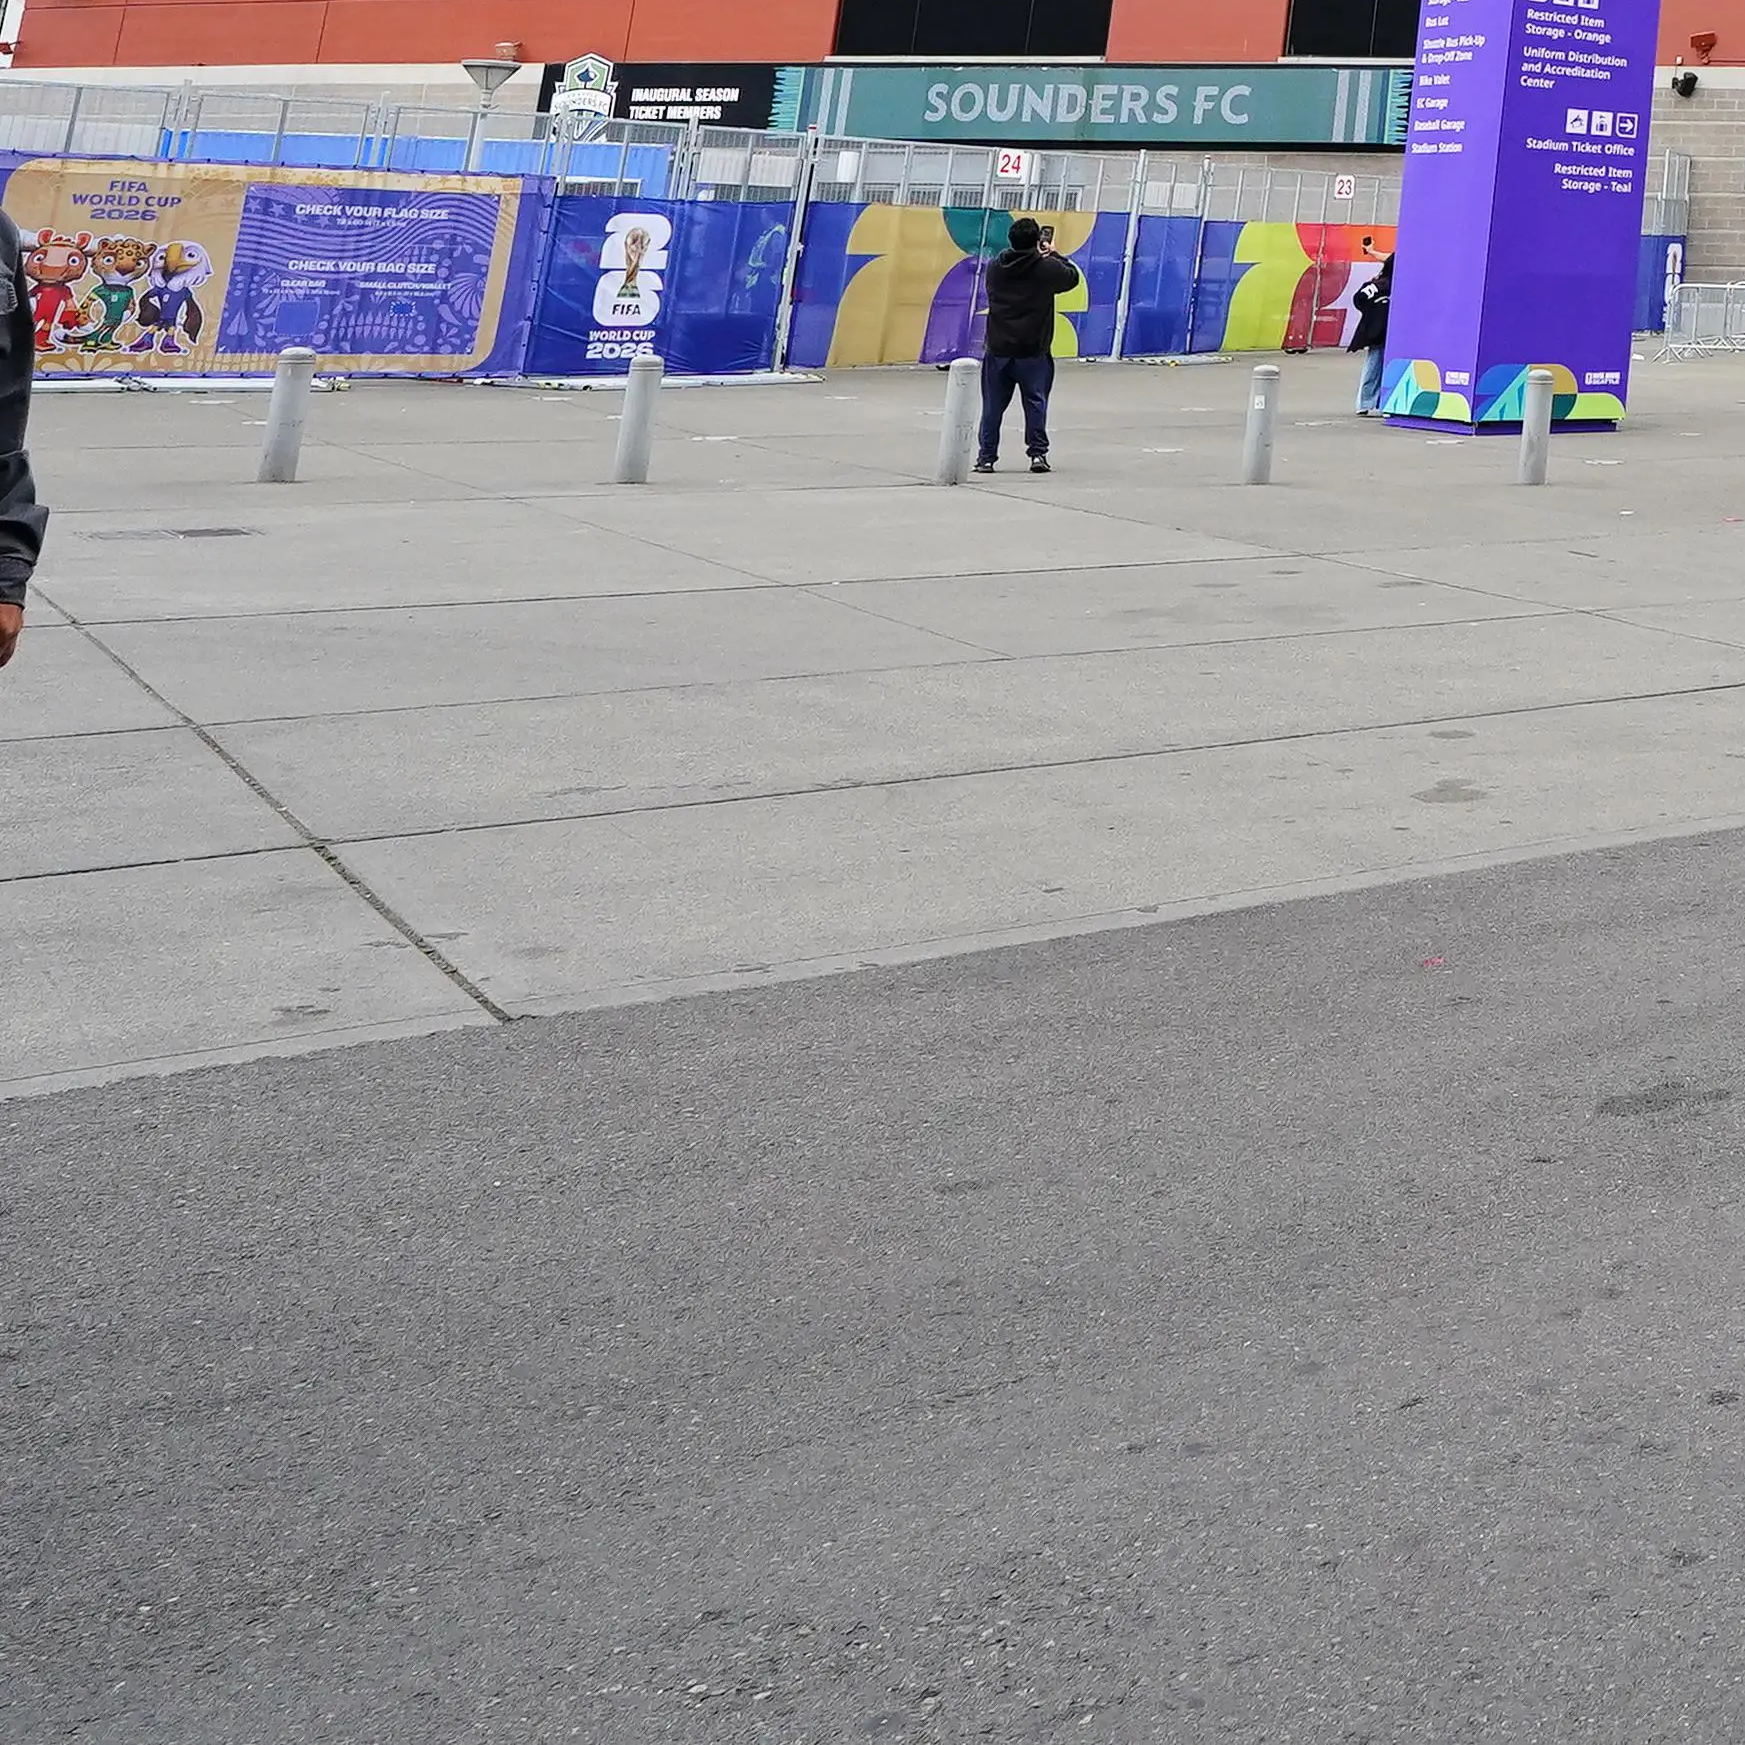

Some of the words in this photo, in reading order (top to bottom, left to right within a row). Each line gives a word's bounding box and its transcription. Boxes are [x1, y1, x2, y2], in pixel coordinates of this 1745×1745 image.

[1527, 8, 1579, 26] Restricted
[1580, 16, 1605, 28] Item
[1525, 23, 1566, 40] Storage
[1574, 30, 1612, 45] Orange
[1523, 46, 1566, 61] Uniform
[1568, 50, 1628, 68] Distribution
[1521, 62, 1542, 73] and
[1543, 65, 1611, 81] Accreditation
[1520, 75, 1555, 89] Center
[631, 88, 693, 103] INAUGURAL
[694, 88, 740, 102] SEASON
[924, 82, 1180, 124] SOUNDERS
[1193, 84, 1252, 124] FC
[1426, 97, 1449, 110] Garage
[629, 106, 667, 120] TICKET
[667, 106, 722, 120] MEMBERS
[1441, 119, 1466, 132] Garage
[1411, 142, 1437, 154] Stadium
[1438, 142, 1463, 153] Station
[1526, 137, 1569, 152] Stadium
[1571, 141, 1602, 154] Ticket
[1604, 141, 1635, 157] Office
[1000, 154, 1022, 173] 24
[1554, 162, 1606, 178] Restricted
[1608, 167, 1633, 179] Item
[109, 180, 148, 193] FIFA
[1337, 179, 1352, 195] 23
[1561, 178, 1602, 194] Storage
[1610, 181, 1632, 193] Teal
[72, 193, 140, 207] WORLD
[145, 196, 182, 208] CUP
[90, 208, 157, 221] 2026
[295, 203, 343, 217] CHECK
[344, 205, 384, 219] YOUR
[384, 207, 419, 219] FLAG
[418, 209, 449, 220] SIZE
[288, 260, 338, 272] CHECK
[338, 261, 377, 273] YOUR
[377, 262, 407, 273] BAG
[407, 263, 436, 275] SIZE
[611, 303, 641, 316] FIFA
[588, 330, 631, 342] WORLD
[632, 330, 656, 342] CUP
[585, 342, 654, 360] 2026
